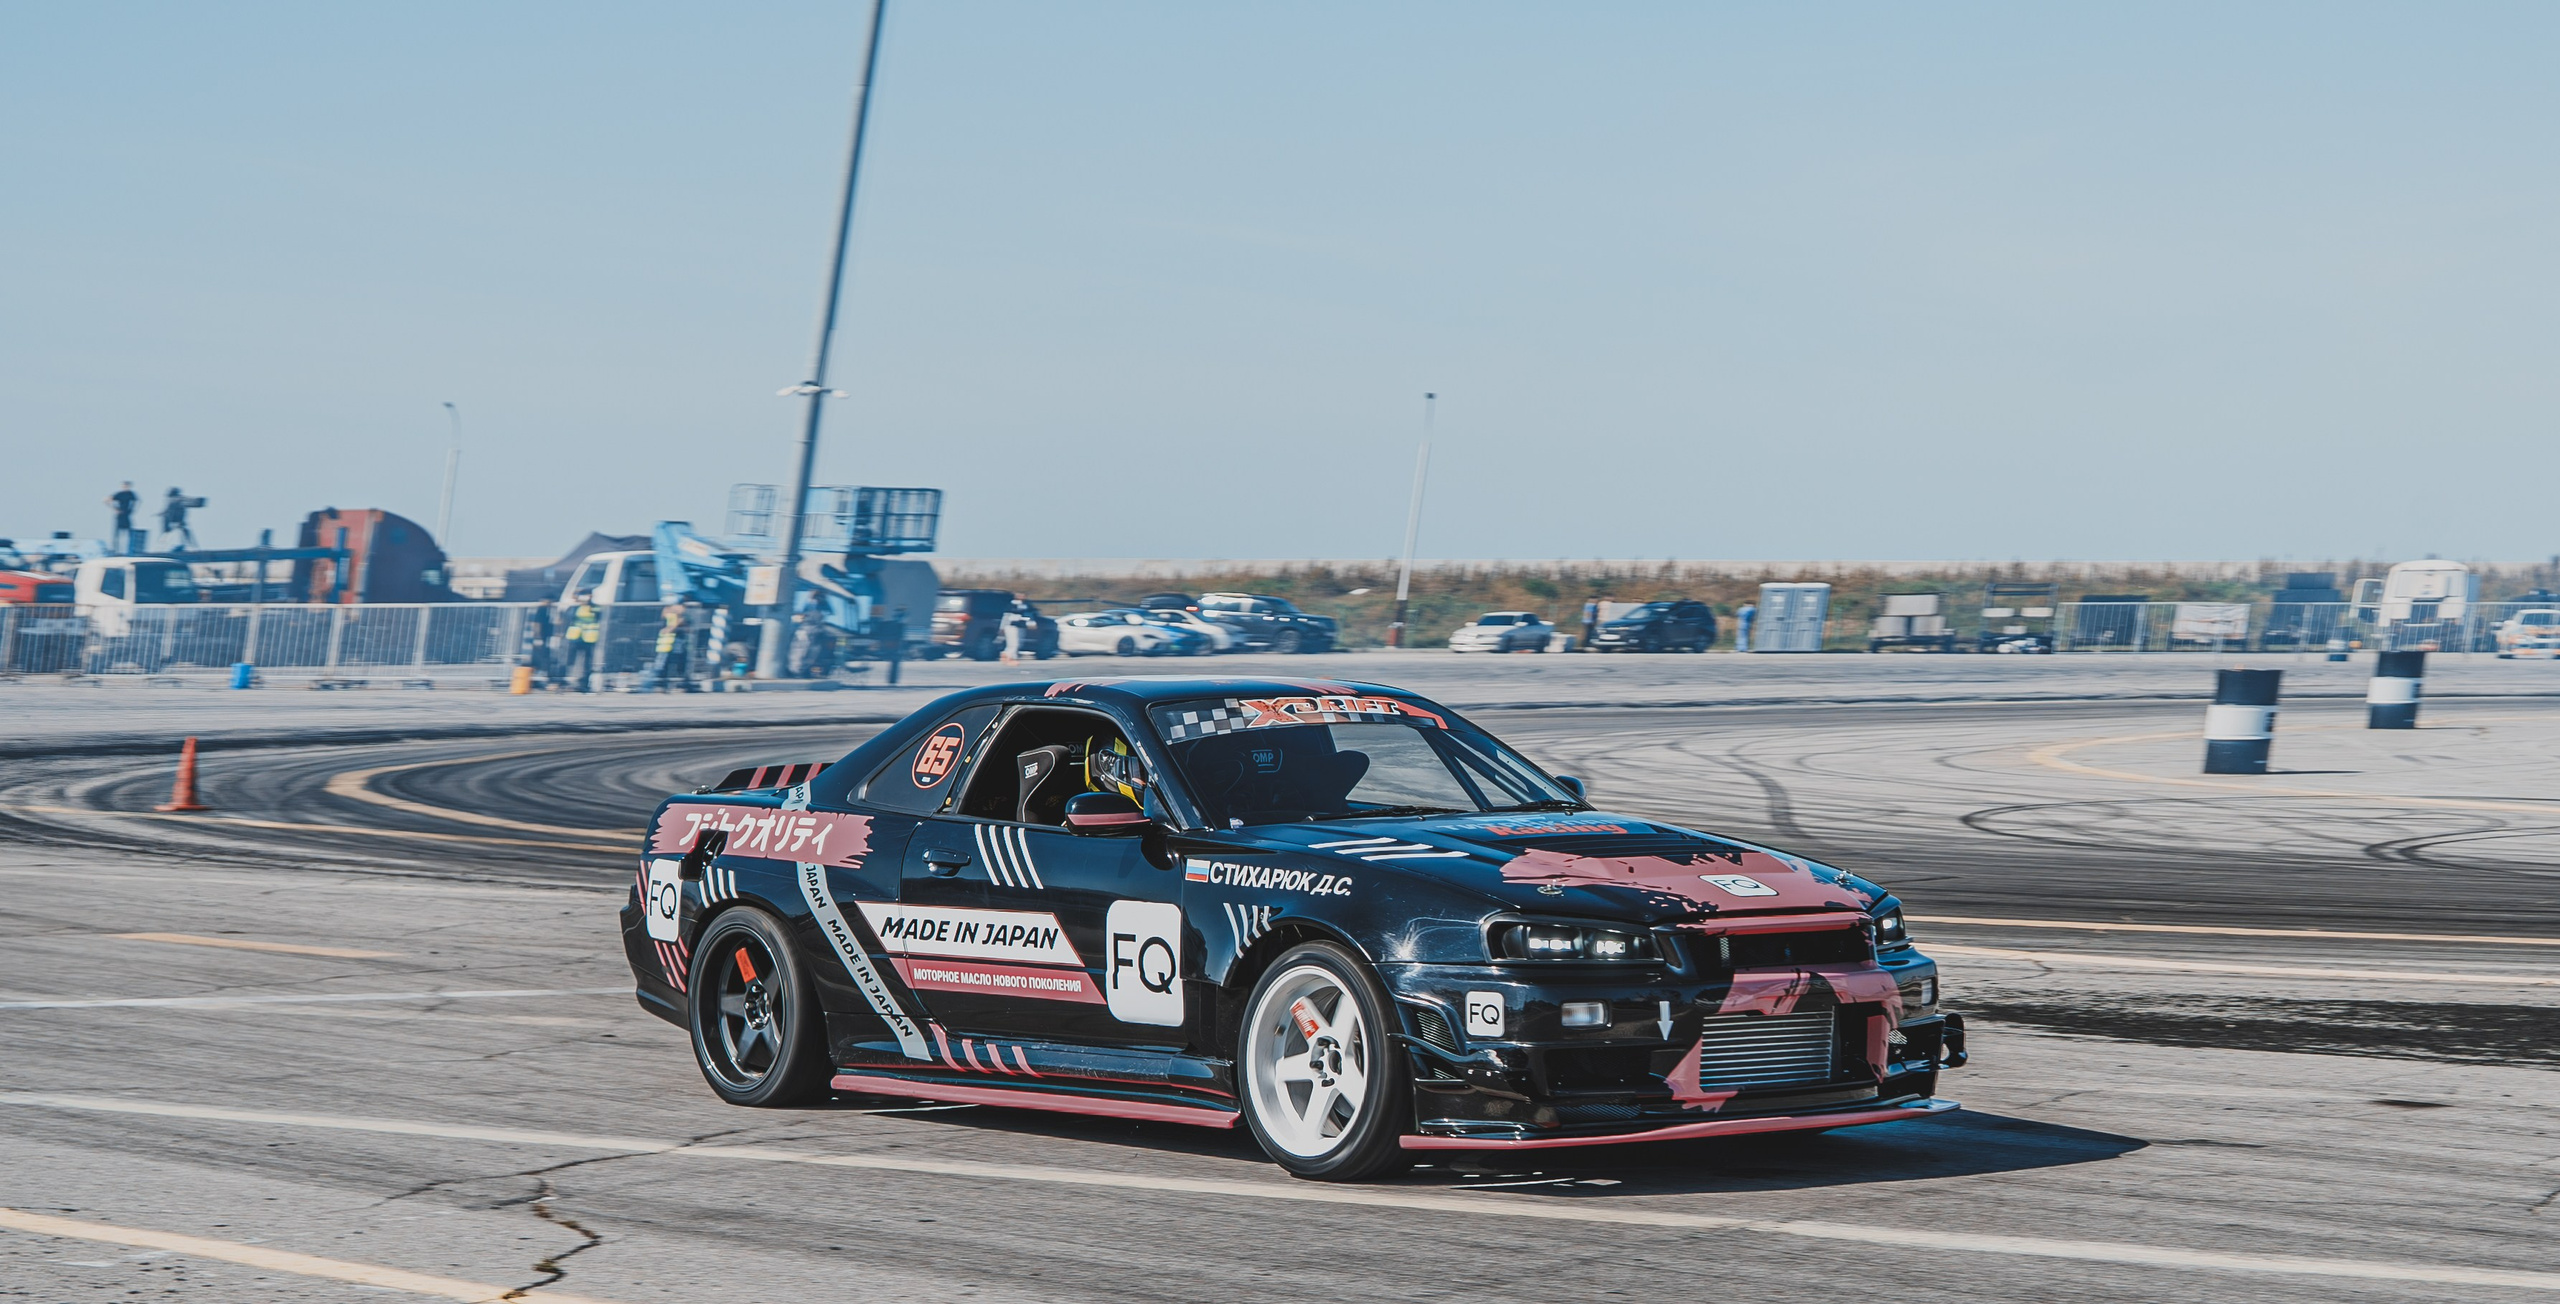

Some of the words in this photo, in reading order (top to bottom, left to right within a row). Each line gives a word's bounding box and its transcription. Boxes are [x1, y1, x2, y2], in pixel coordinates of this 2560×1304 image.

[916, 735, 960, 776] 65
[1252, 752, 1274, 763] OMP
[1485, 823, 1629, 836] Racing
[1209, 862, 1316, 892] СТИХАРЮК
[1713, 879, 1761, 890] FQ
[650, 880, 677, 920] FQ
[880, 916, 950, 942] MADE
[953, 921, 980, 945] IN
[981, 923, 1059, 950] JAPAN
[805, 864, 828, 909] JAPAN
[827, 919, 861, 965] MADE
[857, 966, 874, 984] IN
[869, 986, 914, 1038] JAPAN
[1112, 932, 1177, 994] FQ
[913, 967, 960, 984] МОТОРНОЕ
[960, 973, 992, 986] МАСЛО
[992, 974, 1027, 988] НОВОГО
[1029, 976, 1082, 992] ПОКОЛЕНИЯ
[1470, 1003, 1499, 1025] FQ
